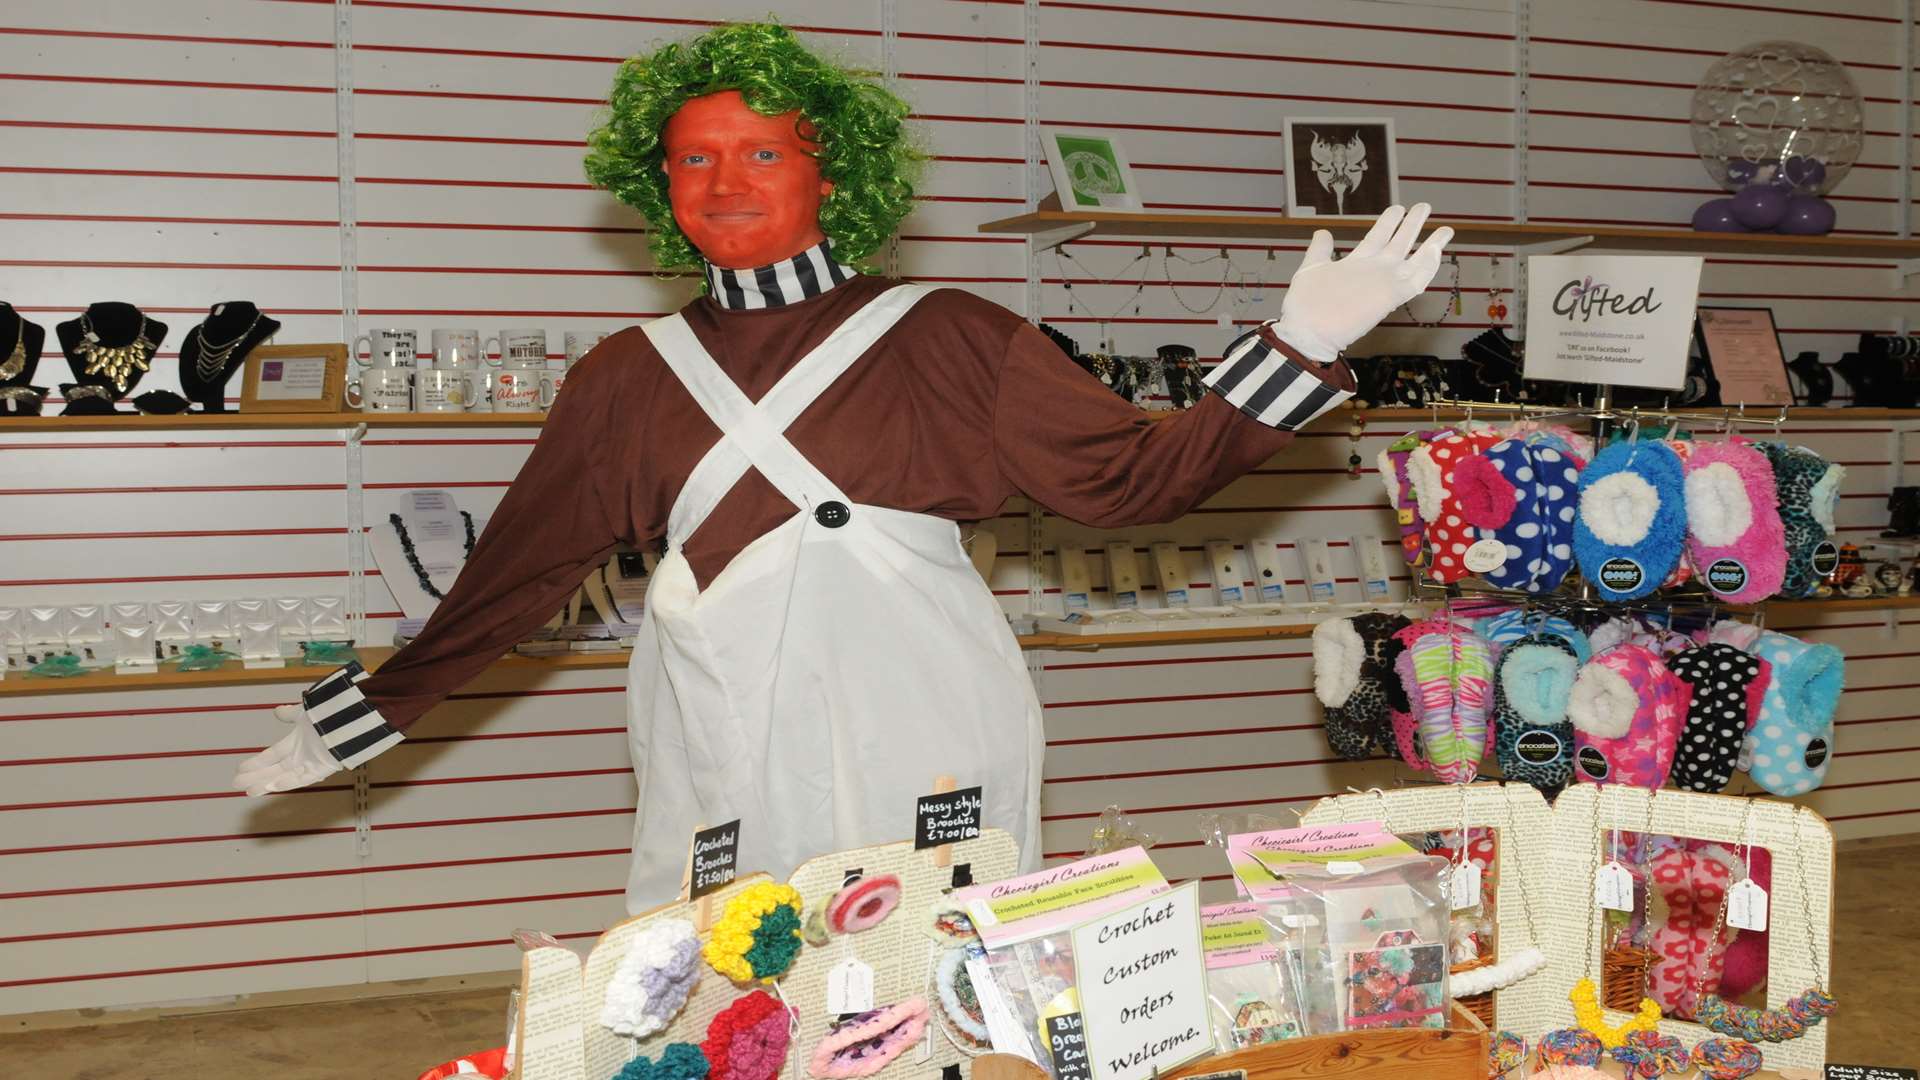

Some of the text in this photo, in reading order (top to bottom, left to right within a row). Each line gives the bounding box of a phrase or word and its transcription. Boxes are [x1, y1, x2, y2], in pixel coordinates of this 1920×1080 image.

[1552, 279, 1662, 322] Gifted
[919, 802, 952, 818] Messy
[926, 815, 975, 830] Brooches
[694, 831, 735, 855] Crocheted
[1309, 830, 1360, 842] Creations
[695, 852, 734, 873] Brooches
[1060, 861, 1121, 882] Creations
[1098, 901, 1175, 944] Crochet
[1103, 947, 1179, 985] Custom
[1120, 990, 1174, 1024] Orders
[1108, 1026, 1201, 1074] Welcome.
[1828, 1065, 1865, 1074] Adult
